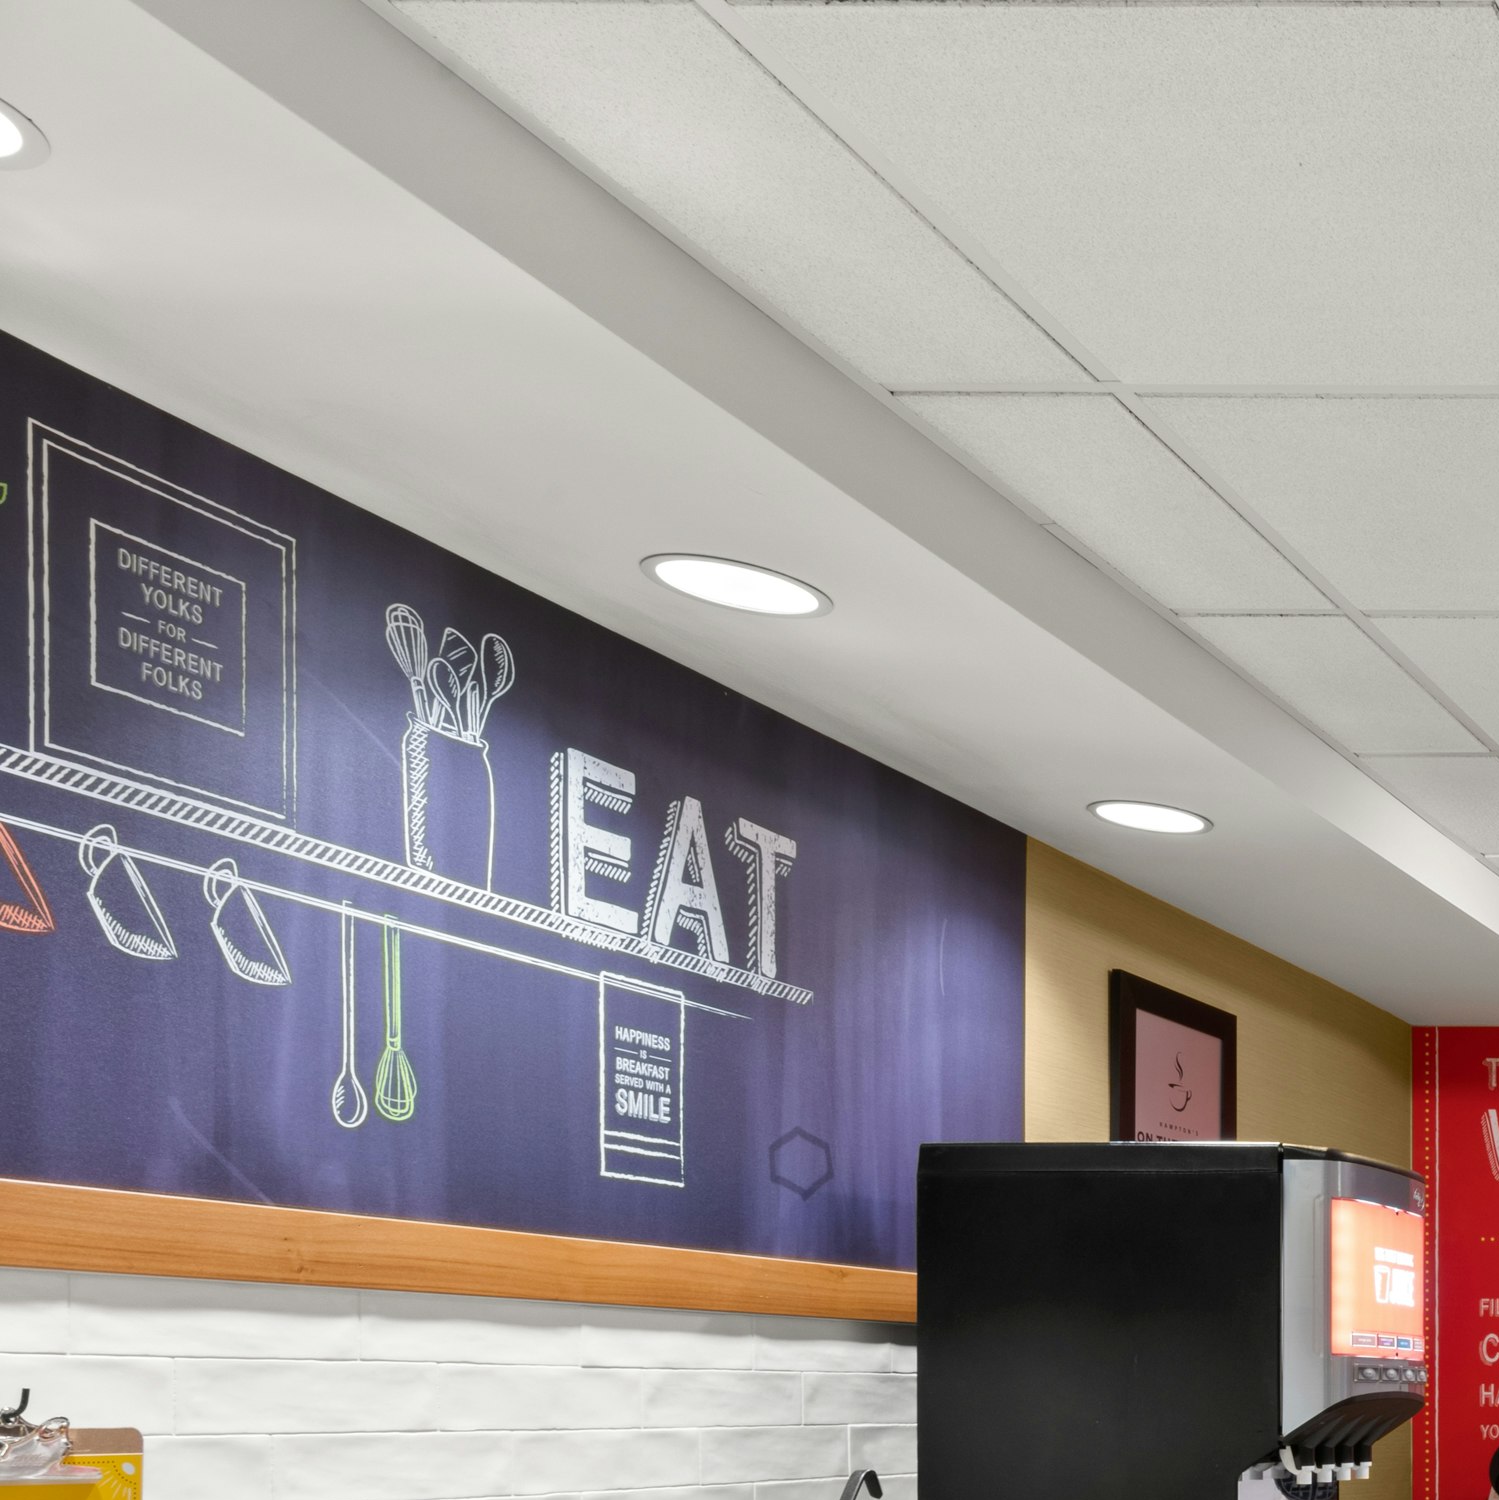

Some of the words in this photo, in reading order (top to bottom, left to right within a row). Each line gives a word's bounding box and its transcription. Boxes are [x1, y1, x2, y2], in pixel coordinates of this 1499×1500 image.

[118, 547, 223, 607] DIFFERENT
[141, 583, 203, 625] YOLKS
[158, 620, 187, 643] FOR
[118, 627, 224, 682] DIFFERENT
[141, 662, 203, 701] FOLKS
[550, 747, 797, 985] EAT
[615, 1025, 671, 1052] HAPPINESS
[615, 1056, 670, 1080] BREAKFAST
[640, 1049, 647, 1060] IS
[614, 1073, 644, 1089] SERVED
[645, 1079, 664, 1093] WITH
[665, 1084, 672, 1095] A
[615, 1088, 671, 1124] SMILE
[1137, 1131, 1153, 1142] ON
